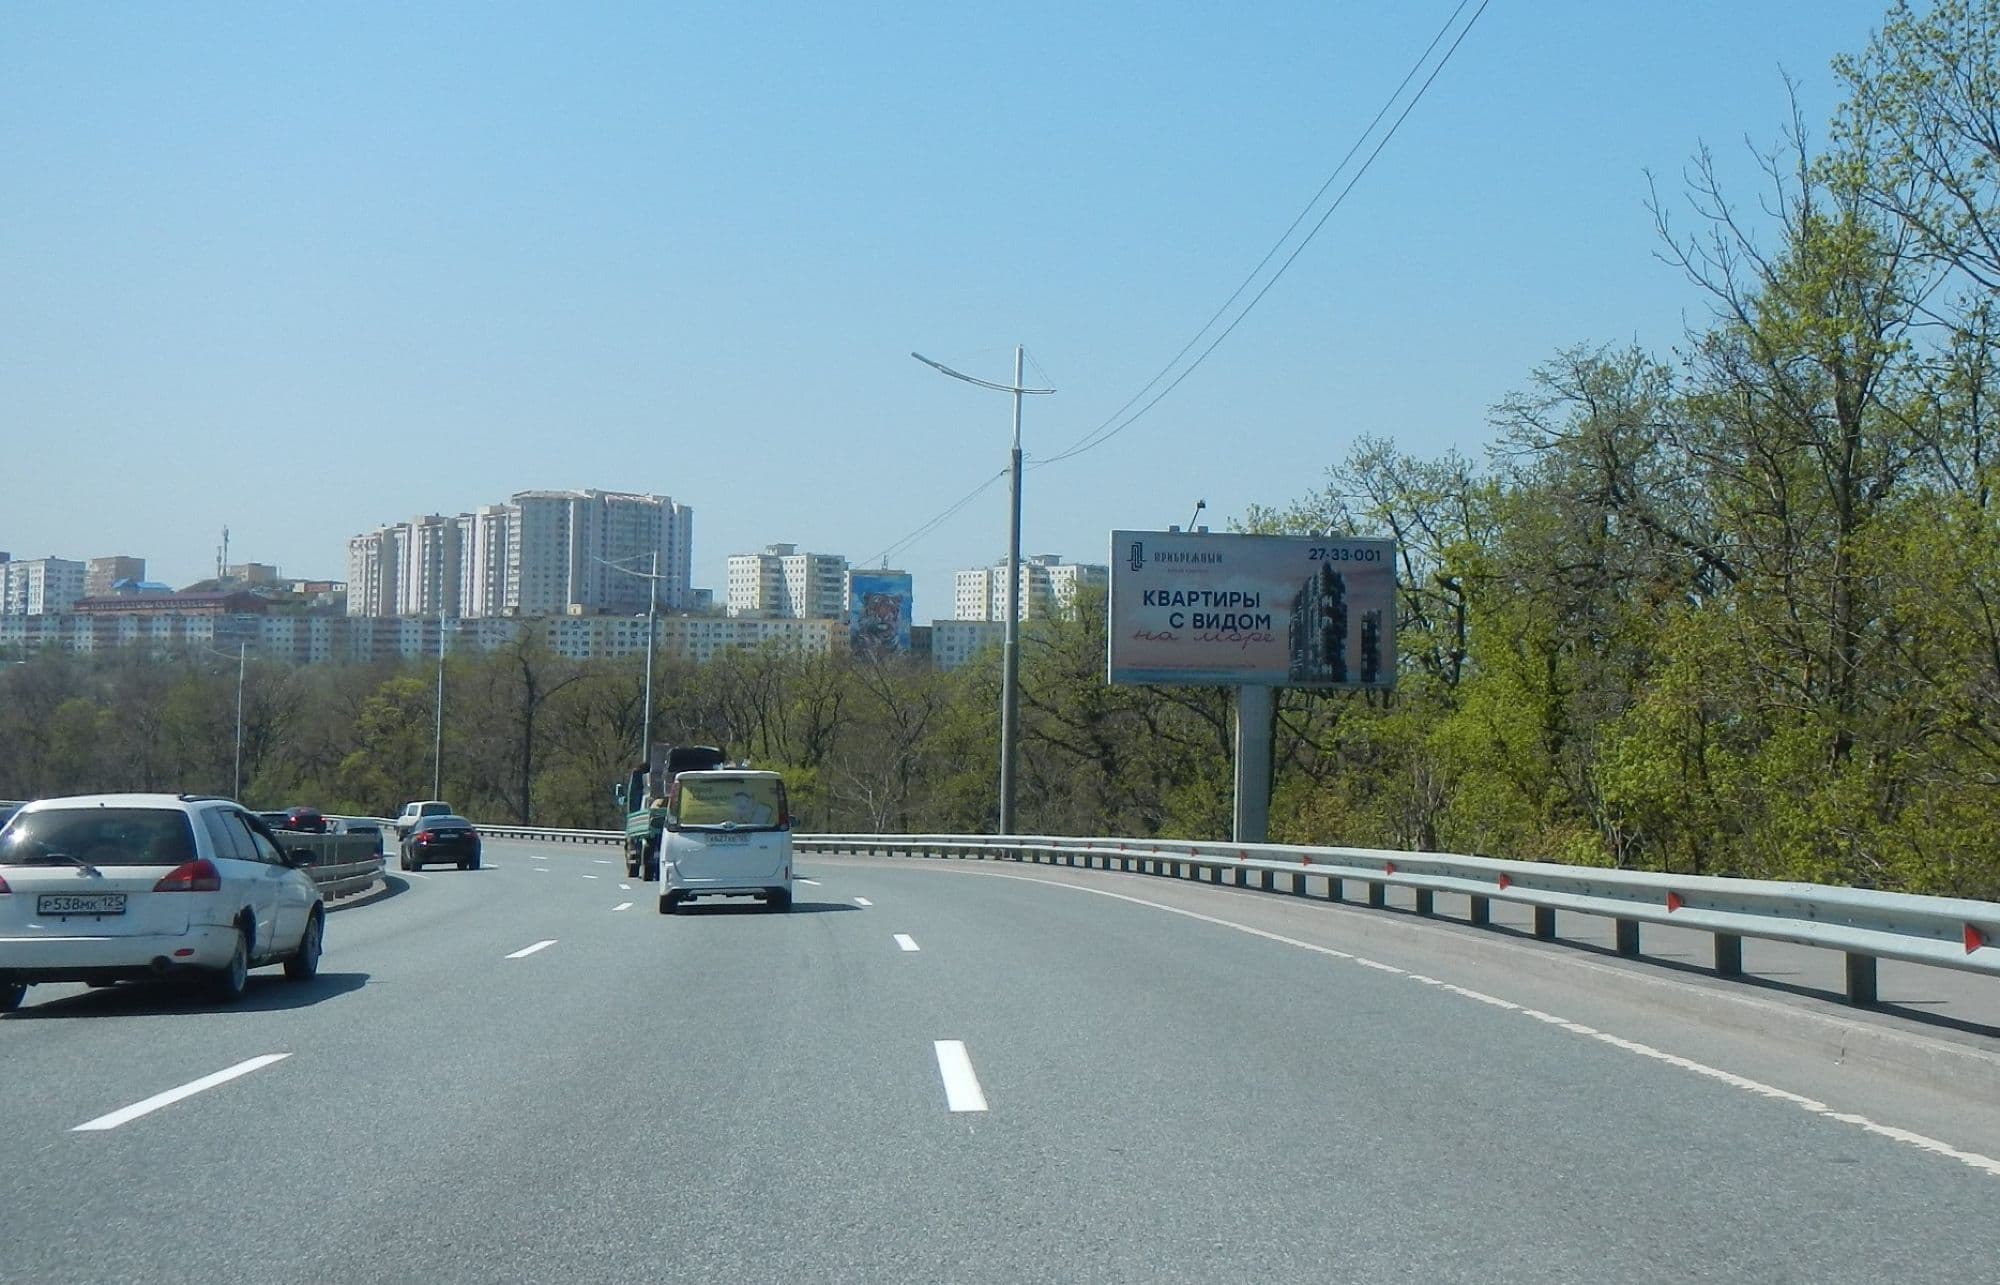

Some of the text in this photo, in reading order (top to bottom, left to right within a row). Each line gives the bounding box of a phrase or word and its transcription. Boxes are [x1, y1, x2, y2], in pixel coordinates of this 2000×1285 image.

[1143, 590, 1260, 608] КВАРТИРЫ
[1169, 612, 1271, 632] С ВИДОМ
[1131, 628, 1275, 650] на море
